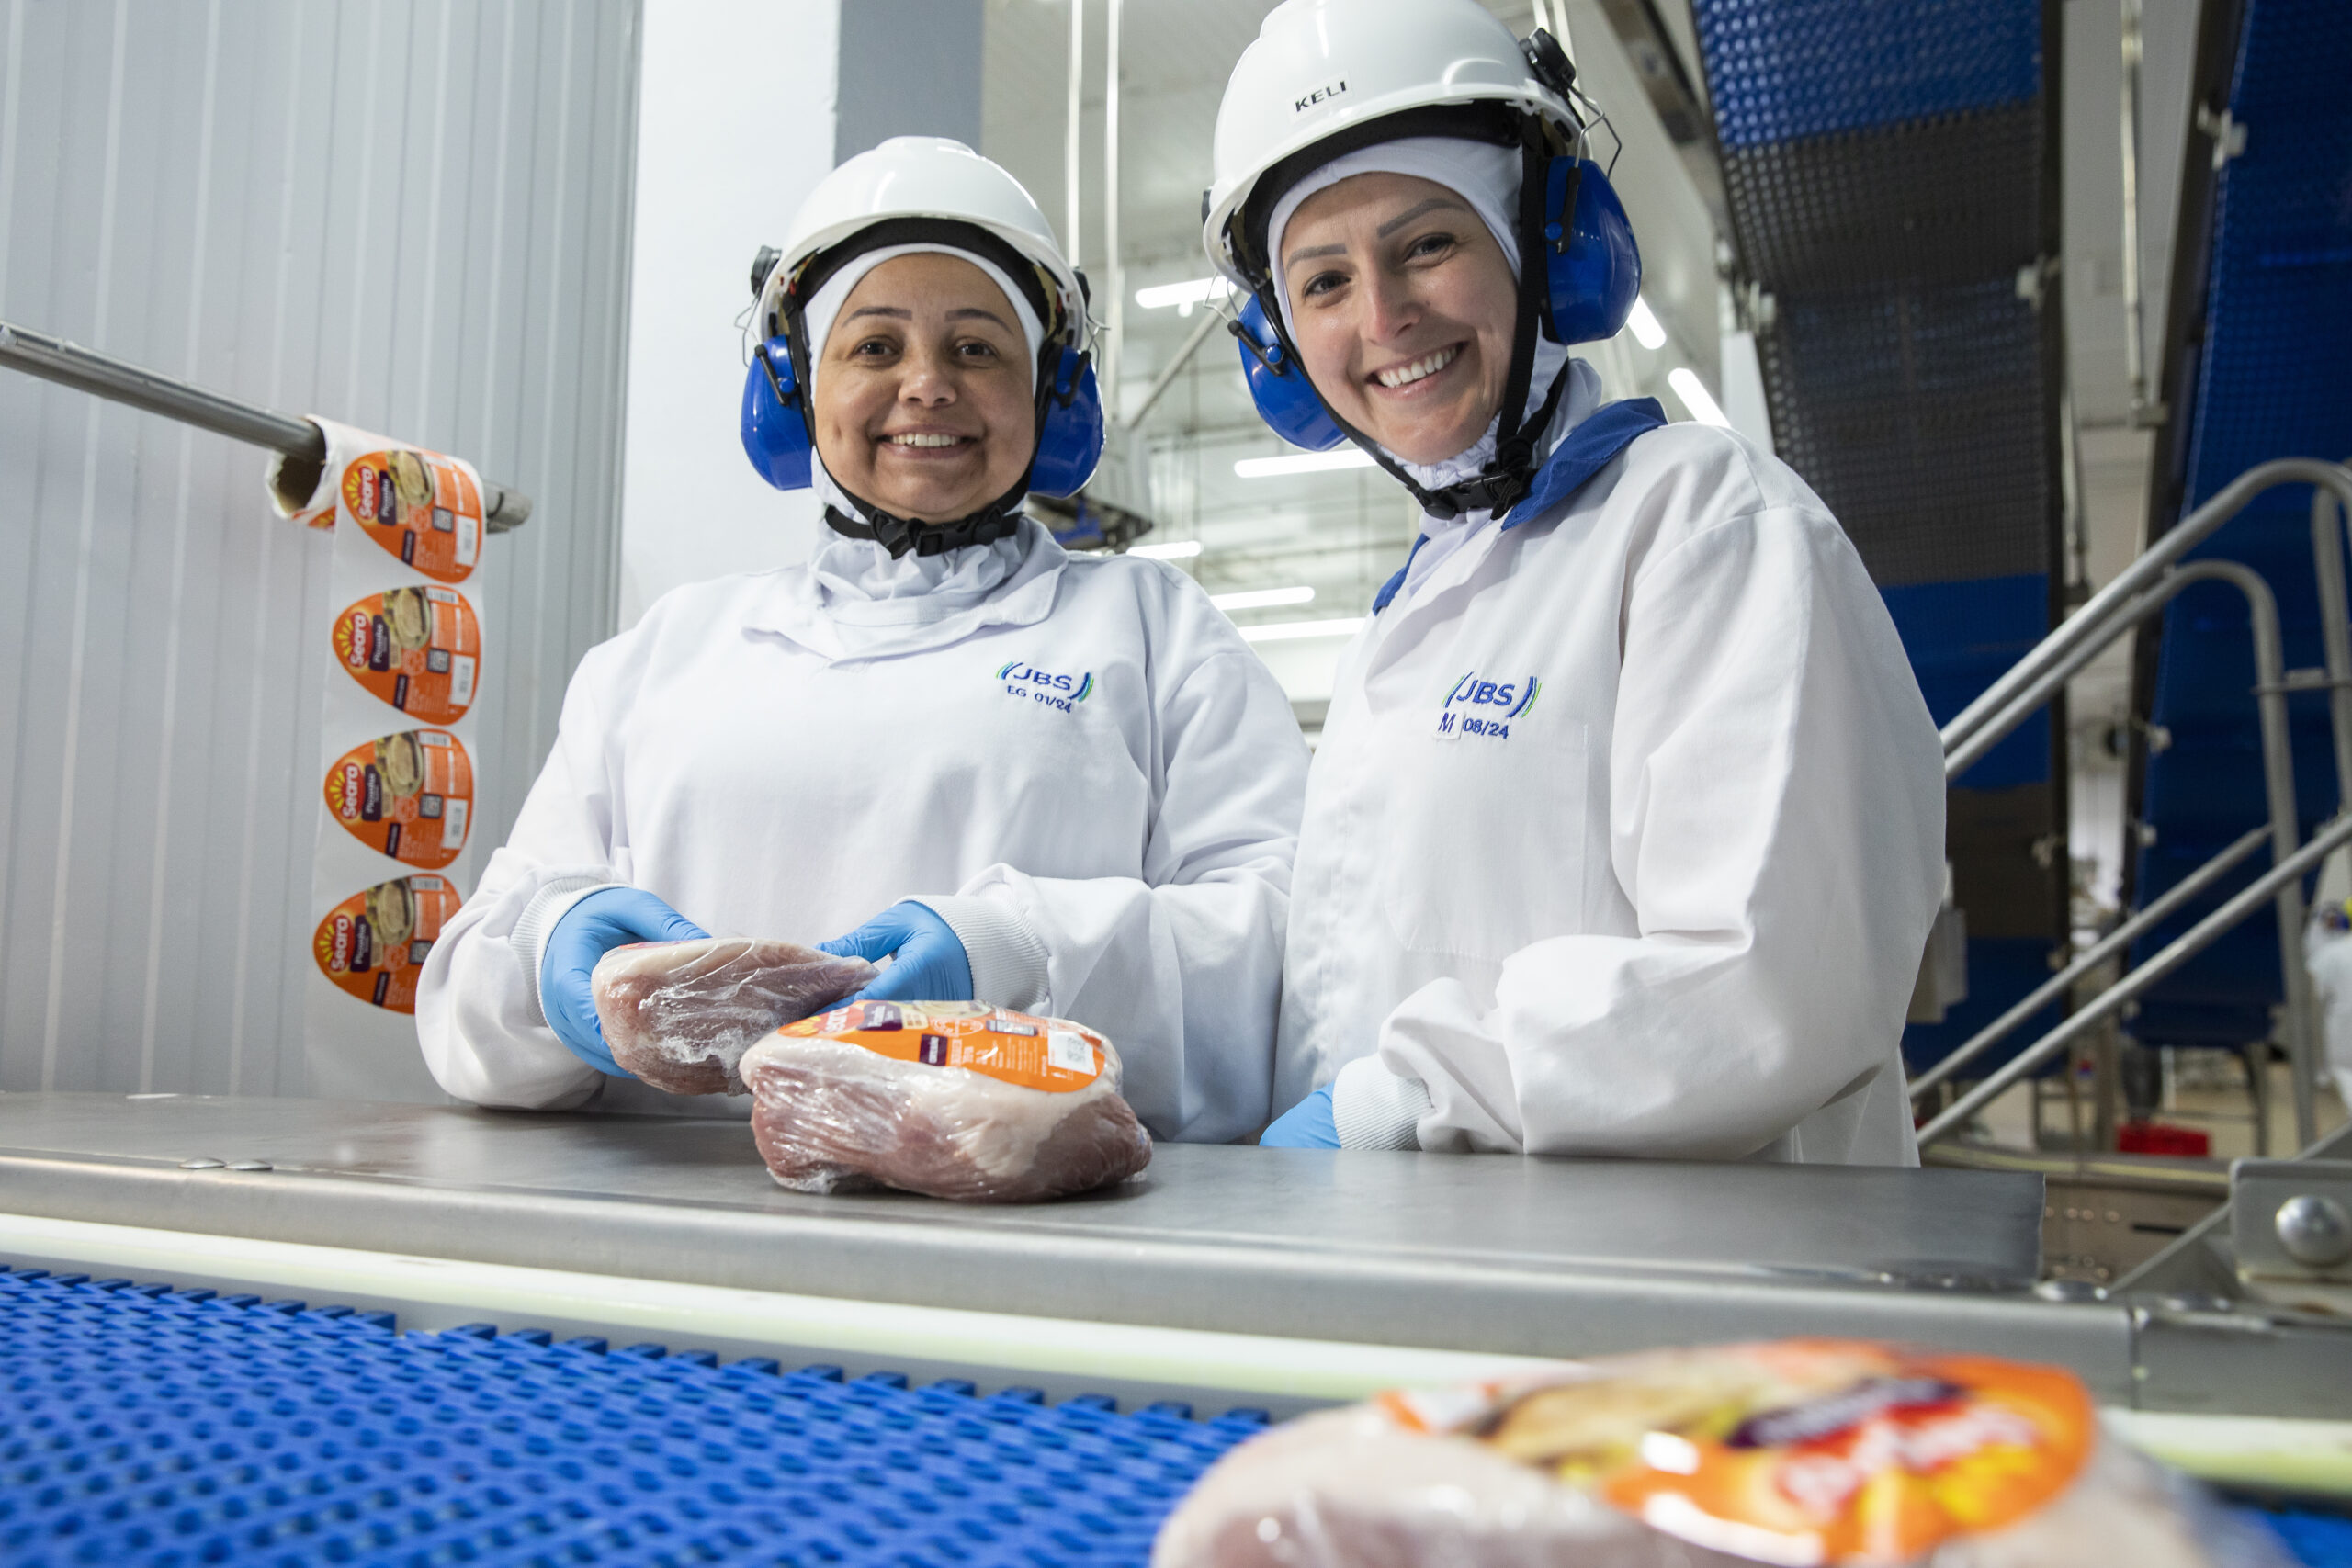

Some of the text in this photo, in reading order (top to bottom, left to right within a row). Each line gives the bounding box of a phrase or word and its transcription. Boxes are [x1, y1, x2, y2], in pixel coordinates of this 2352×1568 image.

[1295, 80, 1347, 113] KELI
[358, 467, 375, 519] Seara
[350, 614, 368, 667] Seara
[1013, 668, 1073, 691] JBS
[1456, 679, 1516, 706] JBS
[1035, 693, 1072, 714] 01/24
[1438, 712, 1509, 739] M 08/24
[341, 765, 360, 819] Seara
[331, 917, 350, 971] Seara
